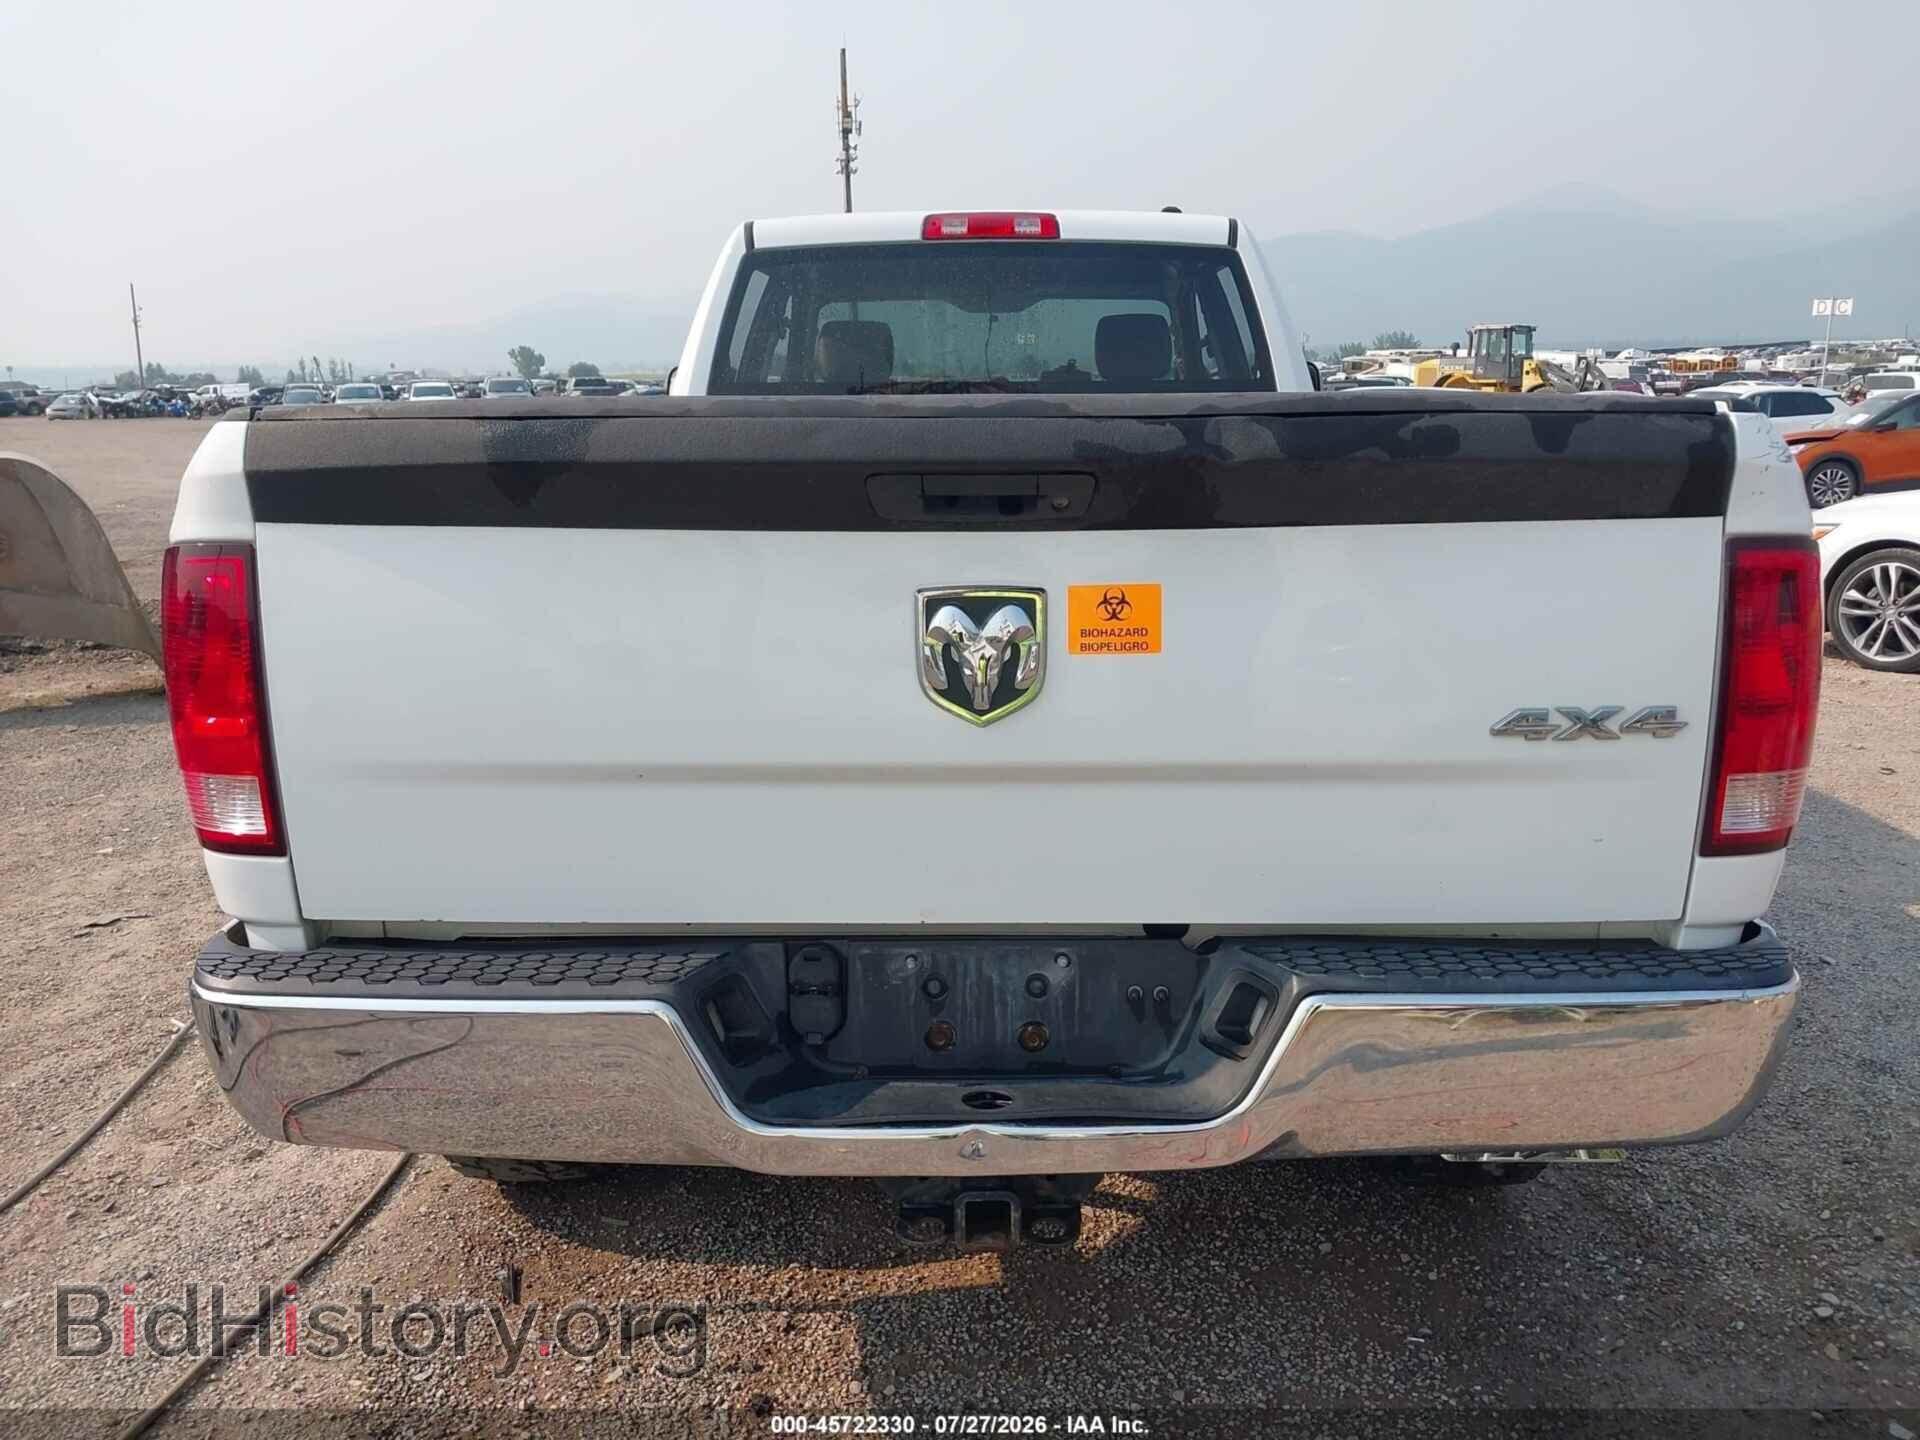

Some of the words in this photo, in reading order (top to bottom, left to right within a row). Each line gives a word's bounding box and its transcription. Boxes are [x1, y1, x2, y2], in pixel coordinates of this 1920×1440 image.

[1816, 301, 1827, 313] D
[1838, 300, 1848, 313] C
[1080, 627, 1148, 638] BIOHAZARD
[1080, 641, 1149, 652] BIOPELIGRO
[1490, 706, 1688, 741] 4X4
